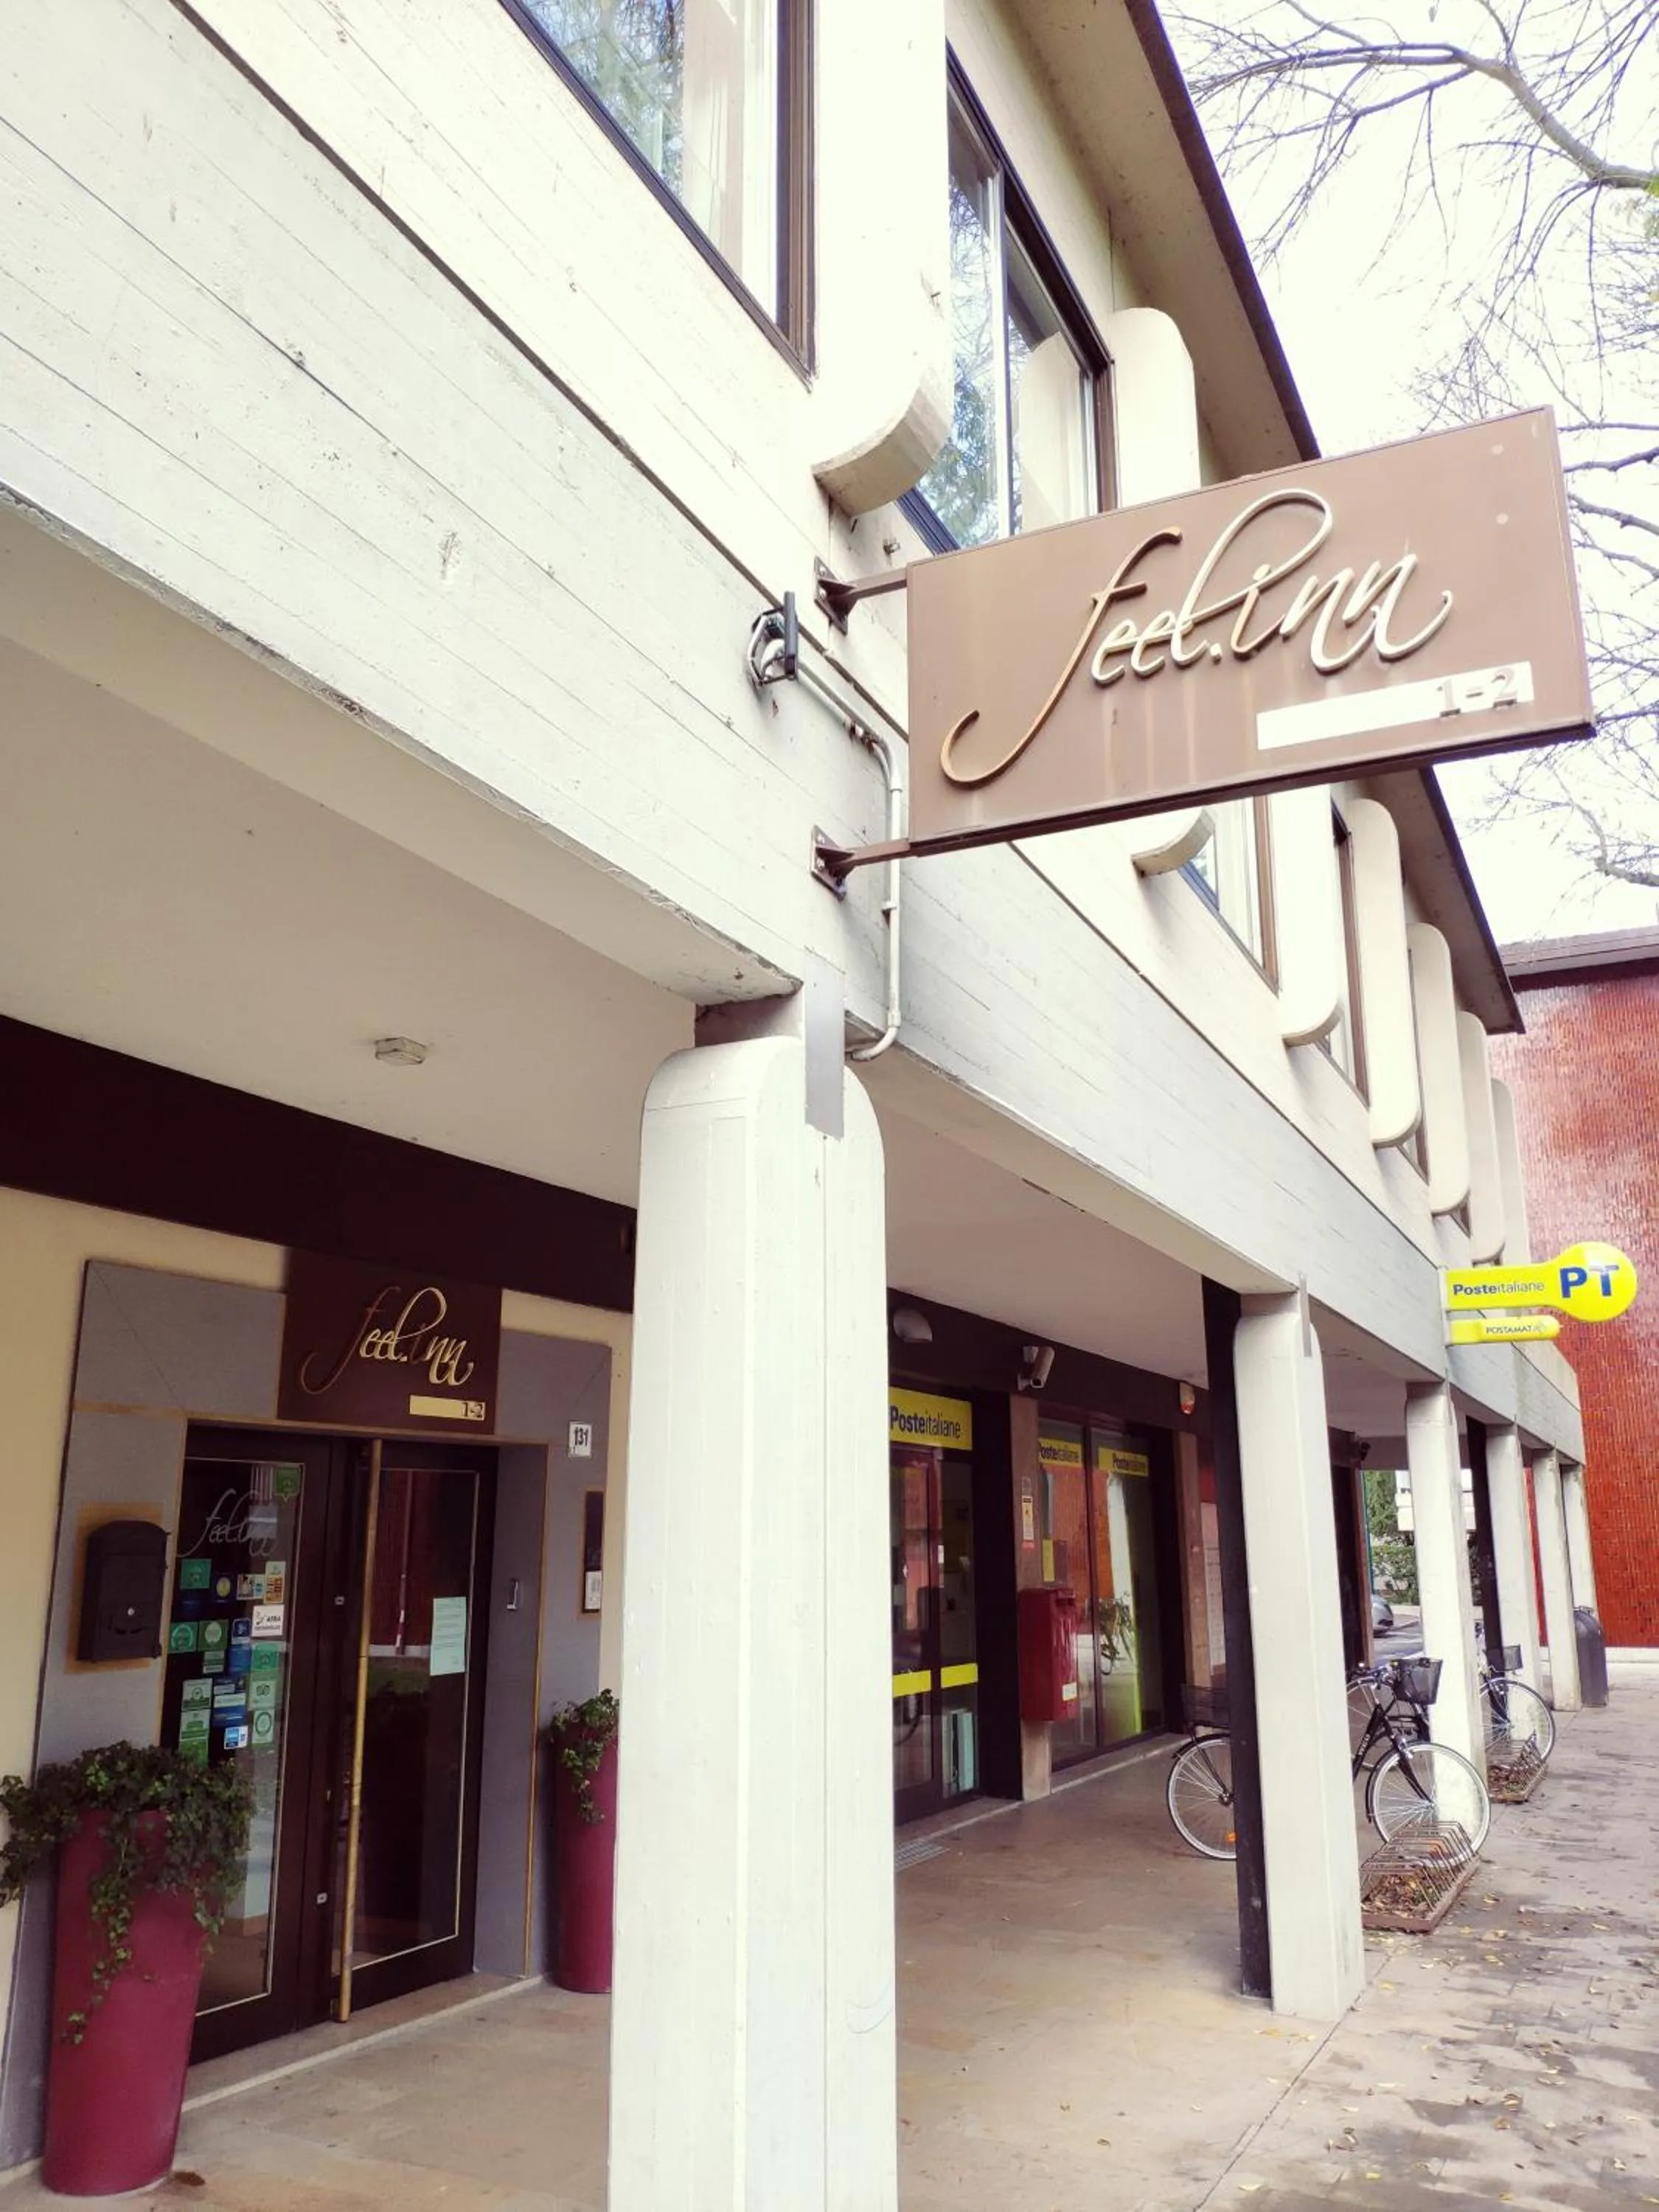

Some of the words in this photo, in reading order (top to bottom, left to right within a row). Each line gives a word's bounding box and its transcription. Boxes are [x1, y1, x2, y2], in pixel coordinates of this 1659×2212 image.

[1437, 667, 1517, 718] 1-2
[1559, 1265, 1619, 1298] PT
[889, 1405, 961, 1439] Posteitaliane
